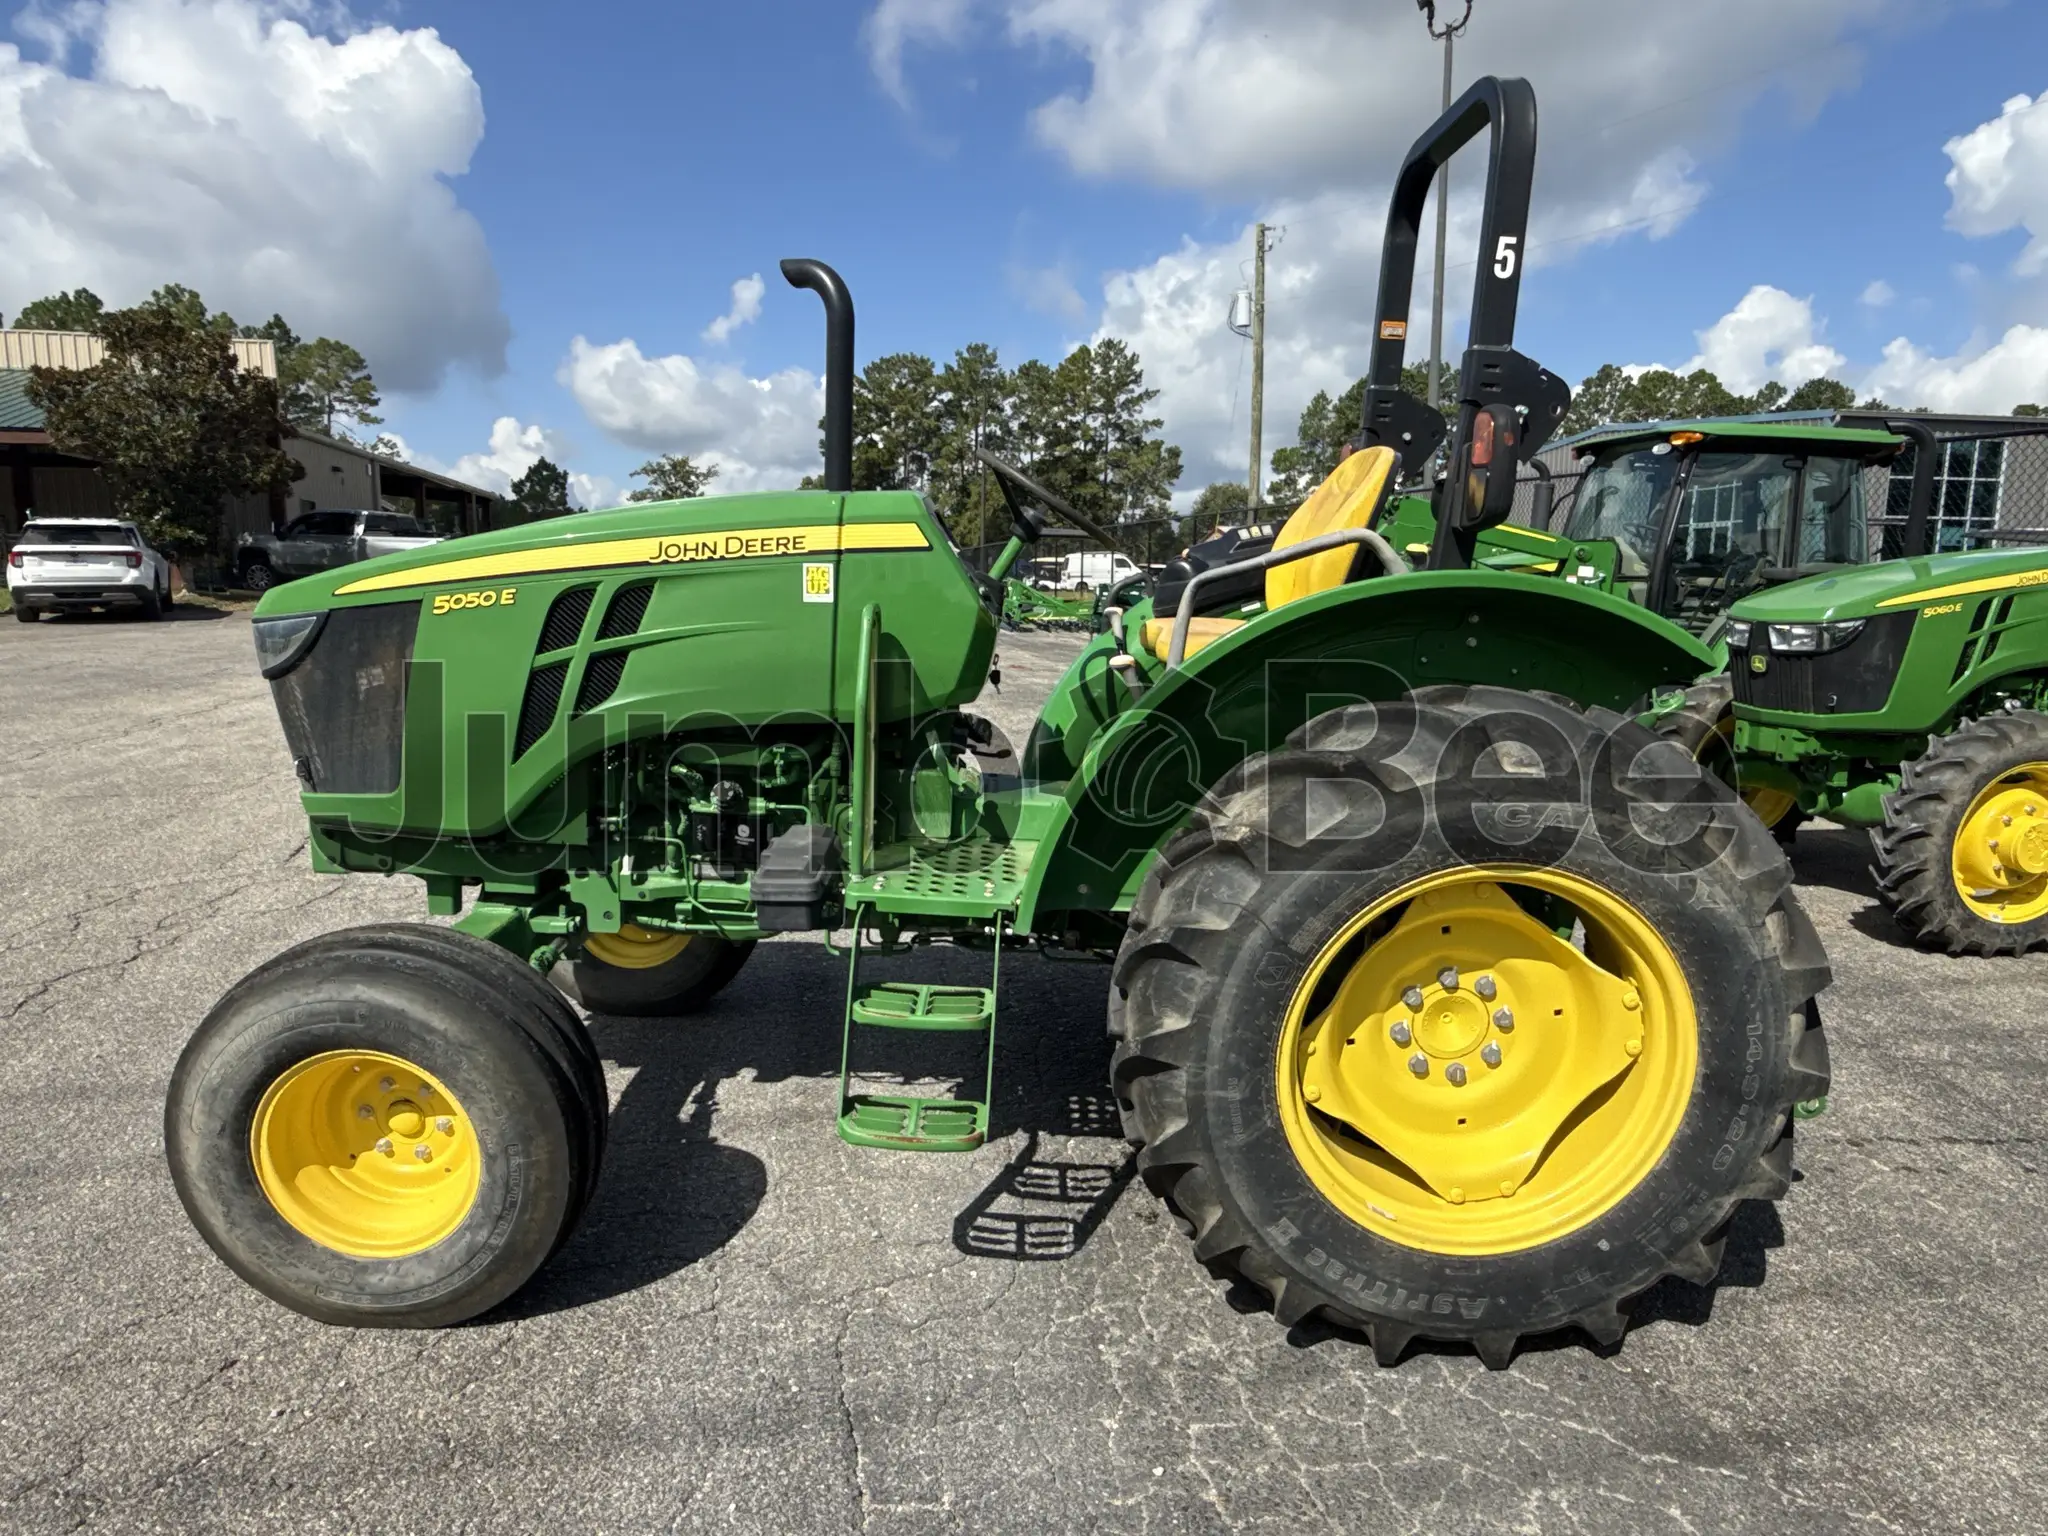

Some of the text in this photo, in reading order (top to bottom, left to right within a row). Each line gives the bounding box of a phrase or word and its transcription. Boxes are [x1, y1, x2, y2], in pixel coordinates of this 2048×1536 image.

[1493, 236, 1517, 279] 5
[649, 535, 806, 560] JOHN DEERE
[807, 567, 829, 580] AG
[2016, 574, 2040, 586] JOHN
[807, 580, 829, 594] UP
[432, 588, 517, 615] 5050 E
[1923, 603, 1963, 618] 5060 E
